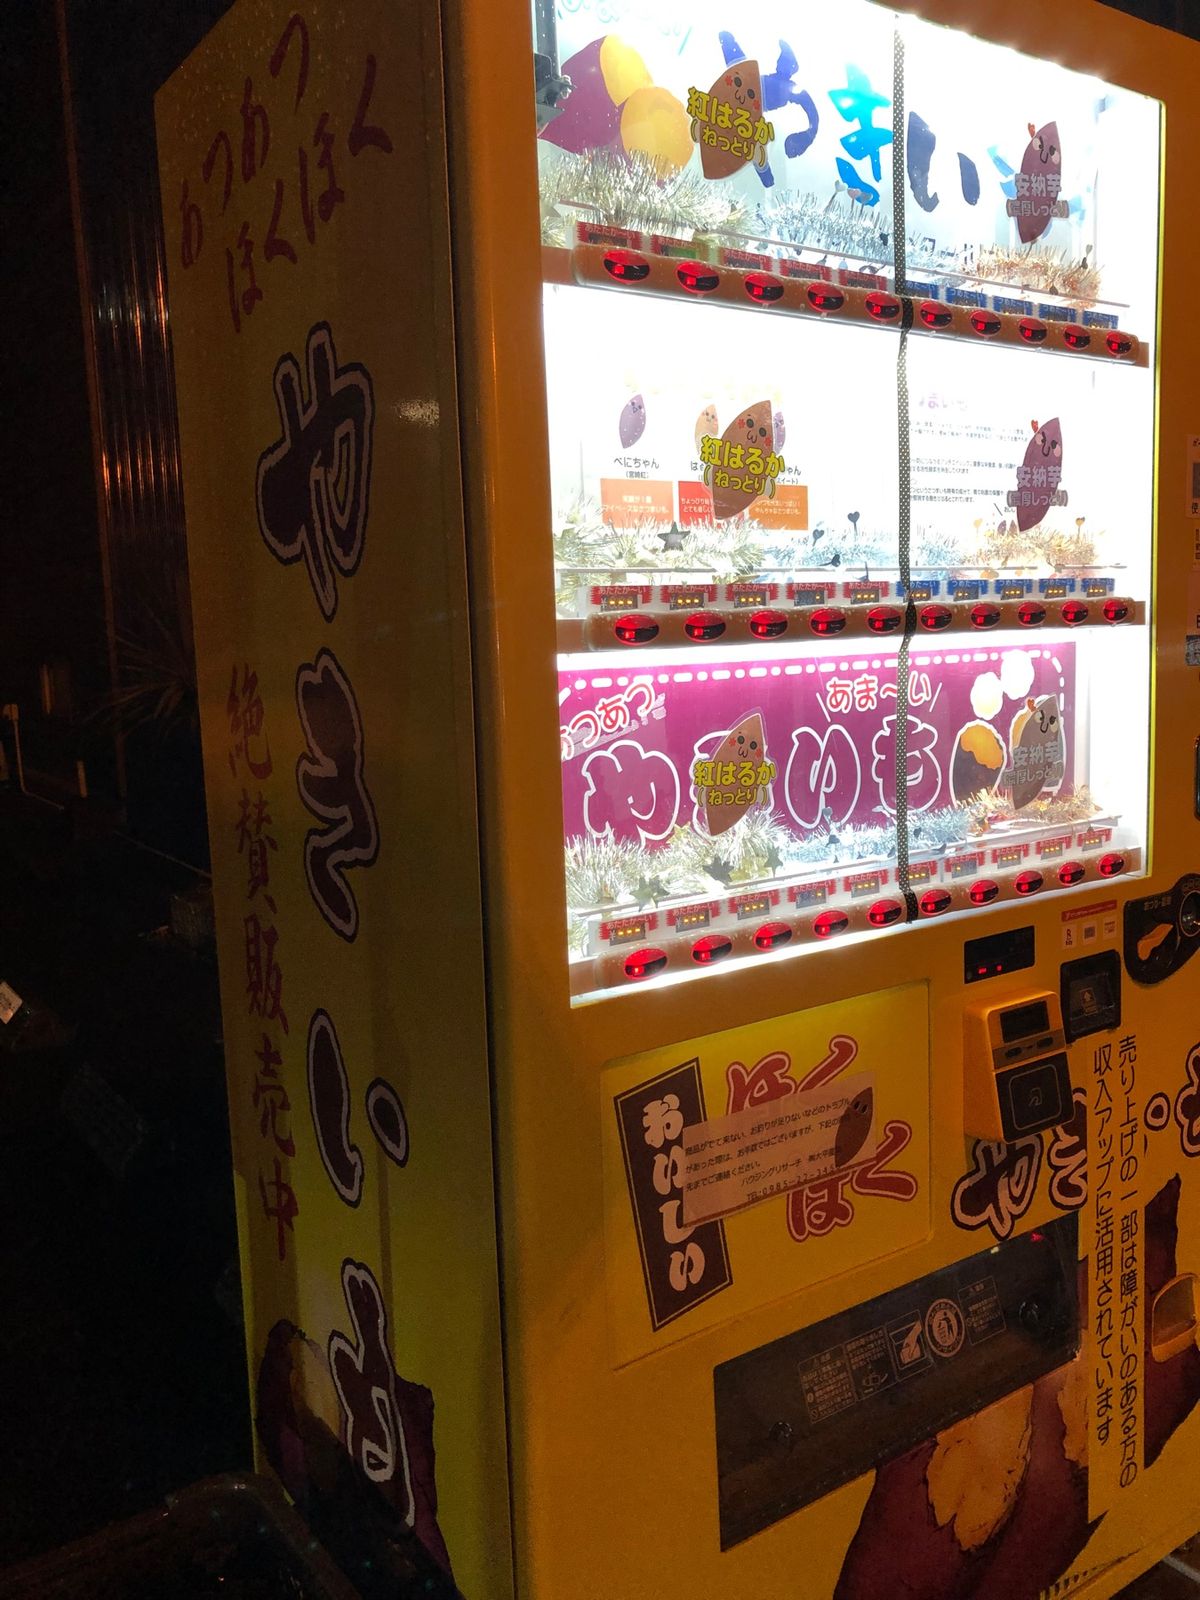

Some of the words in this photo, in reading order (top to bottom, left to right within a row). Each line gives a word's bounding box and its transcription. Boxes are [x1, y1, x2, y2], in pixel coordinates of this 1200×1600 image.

[688, 86, 775, 148] 紅はるか
[1014, 172, 1062, 198] 安納芋
[613, 456, 660, 470] べにちゃん
[699, 434, 785, 479] 紅はるか
[1016, 465, 1063, 488] 安納芋
[1012, 740, 1061, 768] 安納芋
[693, 760, 777, 787] 紅はるか
[226, 661, 300, 1260] 絶賛販売中
[741, 1158, 802, 1187] ハウジングリサーチ
[641, 1093, 706, 1293] おいしい
[1092, 1043, 1115, 1446] 収入アップに活用されています
[1117, 1034, 1139, 1489] 売り上げの一部は障がいのある方の
